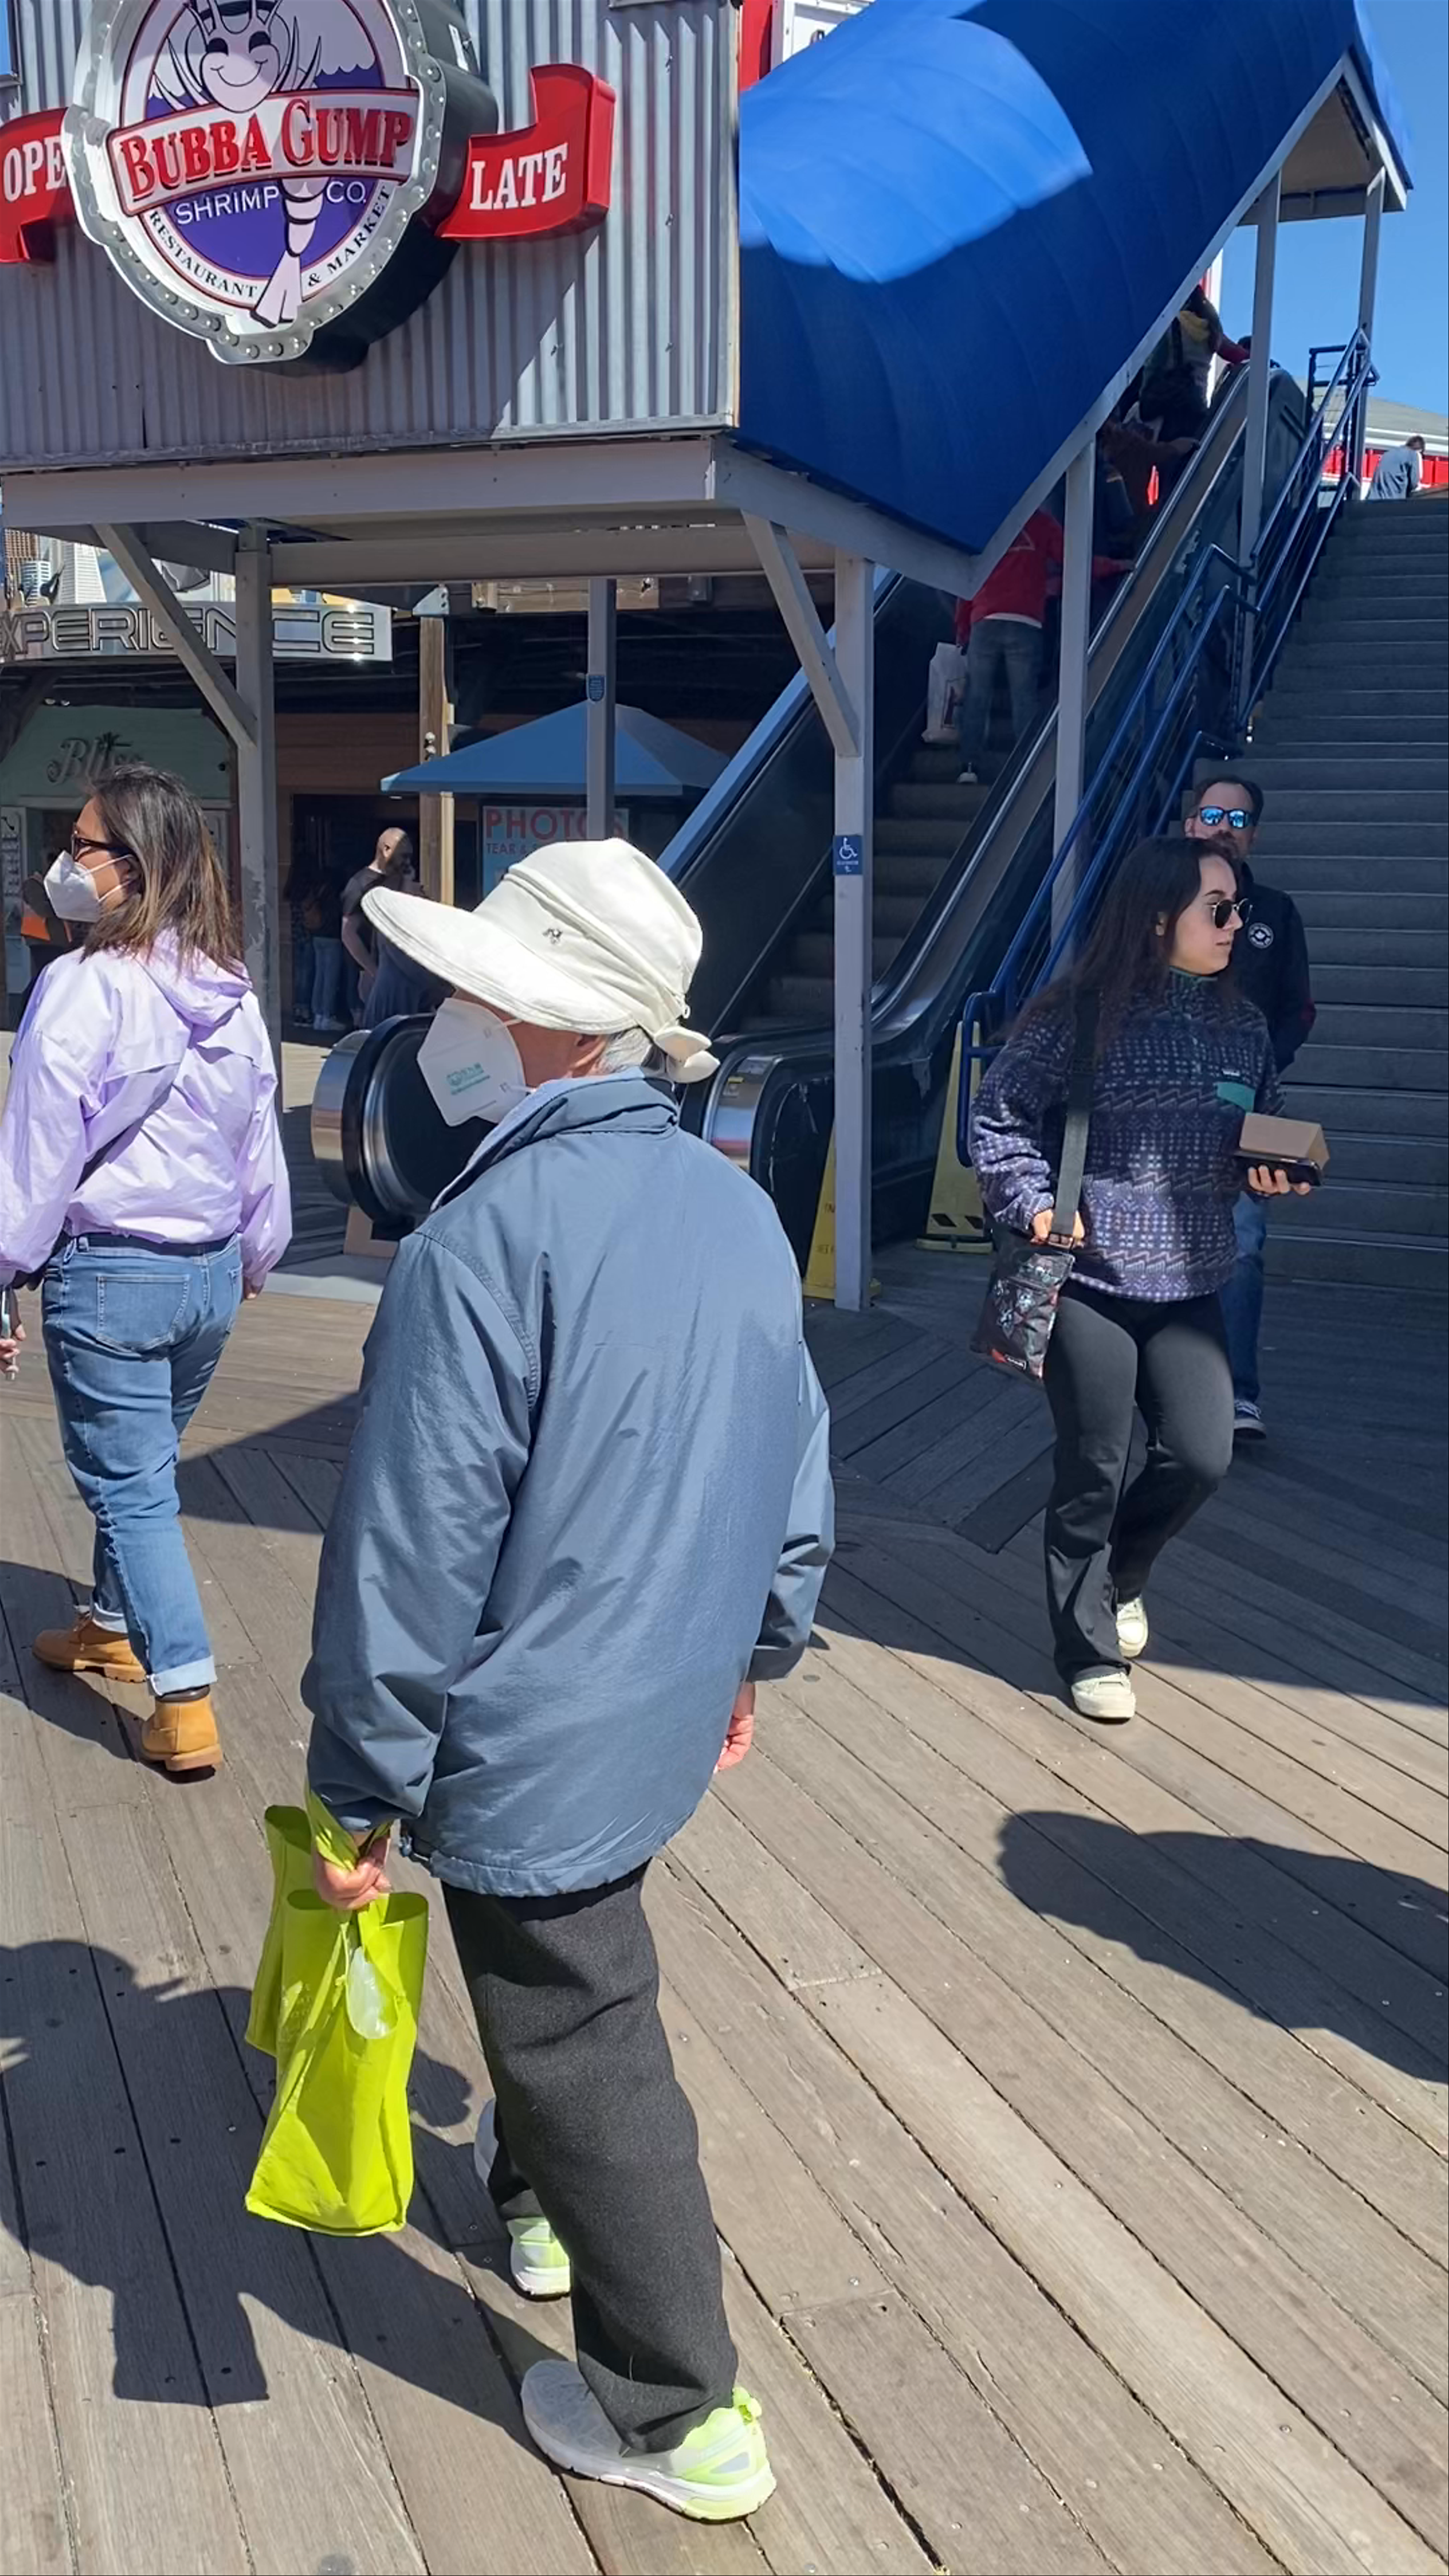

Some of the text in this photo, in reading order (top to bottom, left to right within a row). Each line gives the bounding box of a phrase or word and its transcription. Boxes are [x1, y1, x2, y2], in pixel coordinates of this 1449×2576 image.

[118, 98, 414, 202] BUBBA GUMP
[470, 143, 568, 210] LATE
[175, 186, 279, 224] SHRIMP
[149, 186, 390, 298] RESTAURANT & MARKET
[487, 843, 515, 854] TEAR
